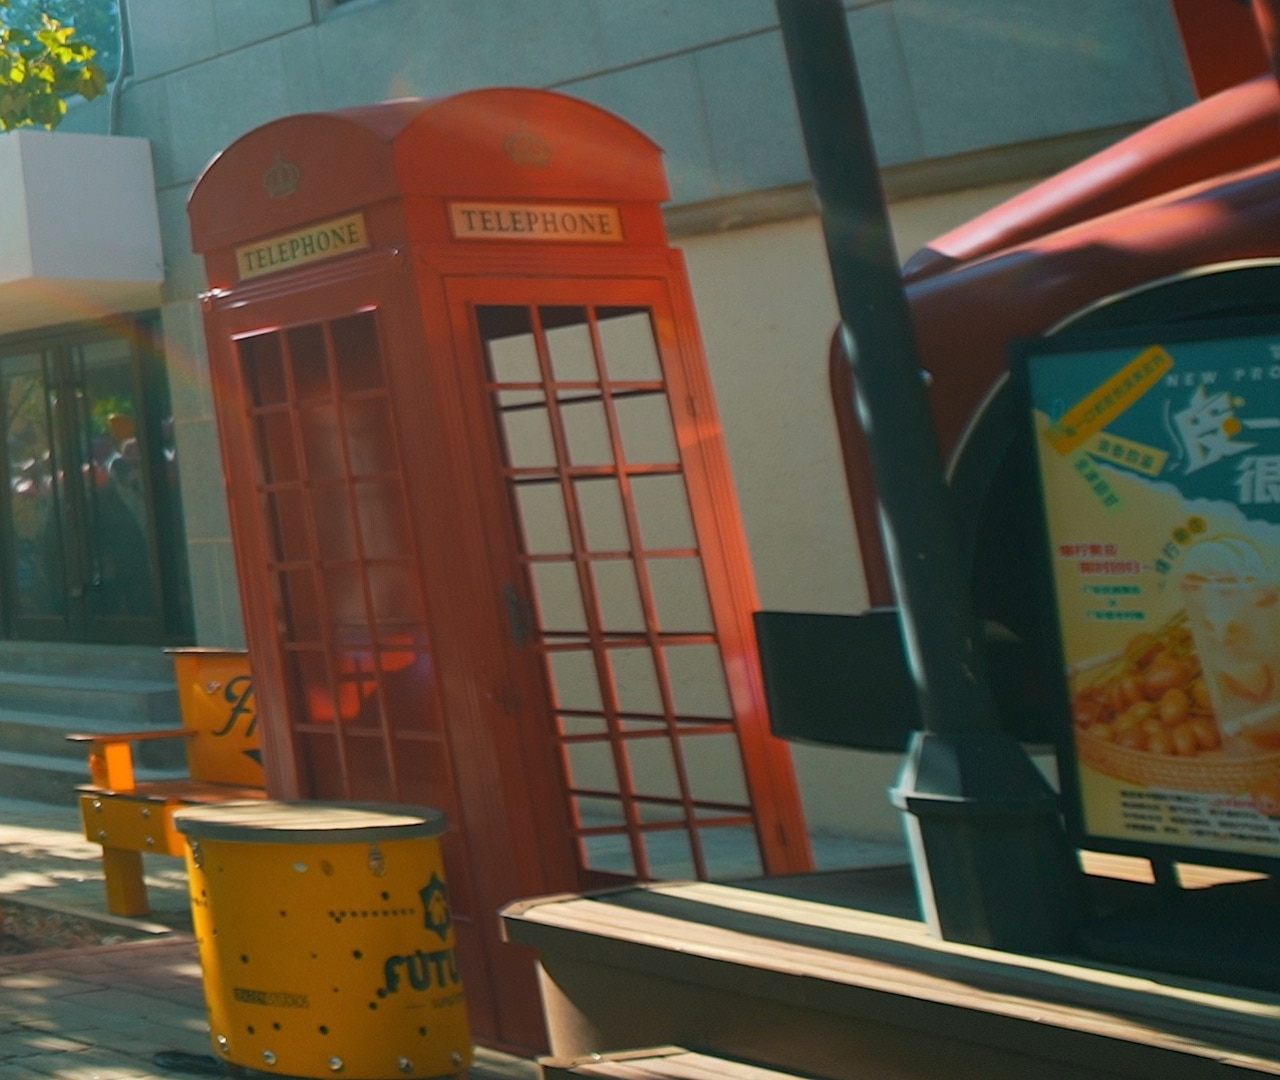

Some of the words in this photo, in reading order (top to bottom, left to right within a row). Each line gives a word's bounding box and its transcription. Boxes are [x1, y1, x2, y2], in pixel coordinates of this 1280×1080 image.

[462, 209, 613, 234] TELEPHONE
[244, 223, 361, 273] TELEPHONE
[1167, 372, 1218, 386] NEW
